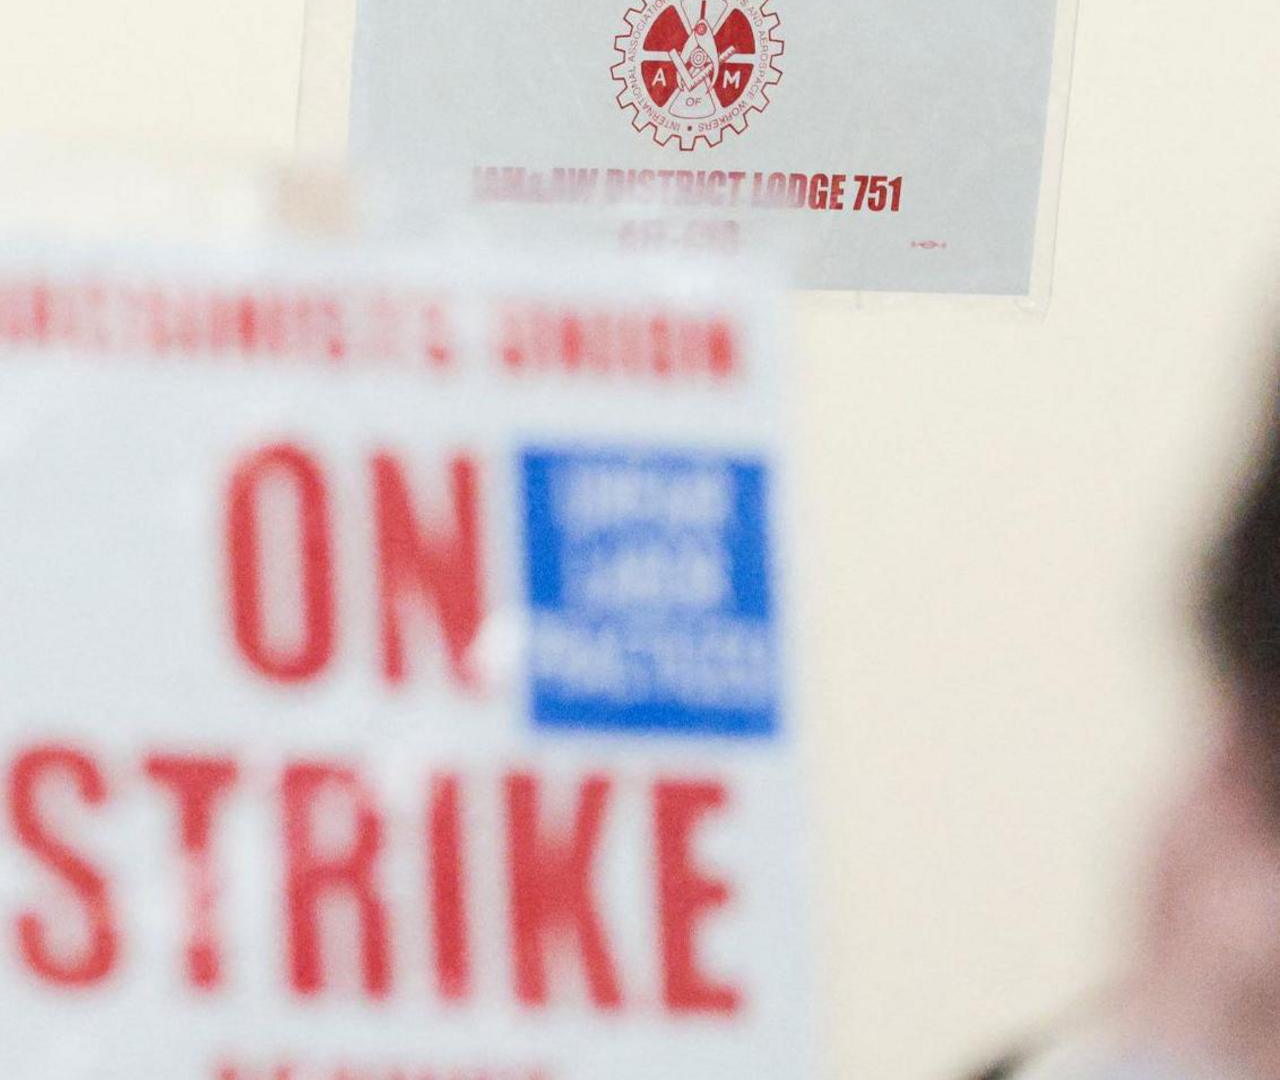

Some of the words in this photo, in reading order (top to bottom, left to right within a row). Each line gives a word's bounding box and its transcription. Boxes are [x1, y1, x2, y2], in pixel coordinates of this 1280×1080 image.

[651, 68, 667, 87] A
[722, 70, 741, 90] M
[685, 97, 703, 107] OF
[606, 168, 747, 206] DISTRICT
[752, 171, 847, 211] LODGE
[852, 174, 903, 213] 751
[220, 439, 488, 690] ON
[2, 741, 743, 1019] STRIKE
